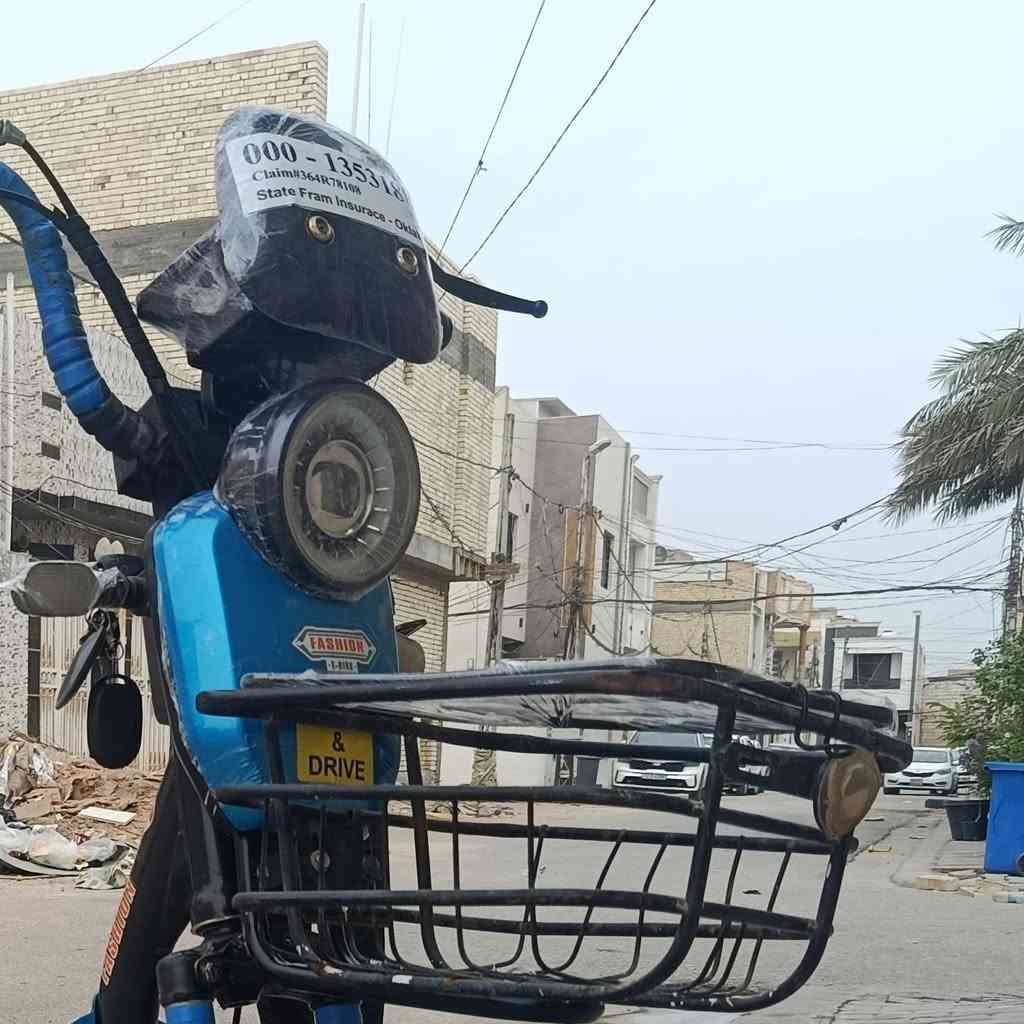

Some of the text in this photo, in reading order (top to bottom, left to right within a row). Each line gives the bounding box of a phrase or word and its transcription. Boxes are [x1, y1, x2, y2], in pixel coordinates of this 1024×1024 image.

[243, 140, 298, 165] 000
[256, 186, 297, 201] State
[298, 187, 334, 205] Fram
[335, 195, 386, 223] Insurace
[310, 637, 365, 653] FASHION
[332, 731, 344, 752] &
[308, 755, 366, 781] DRIVE
